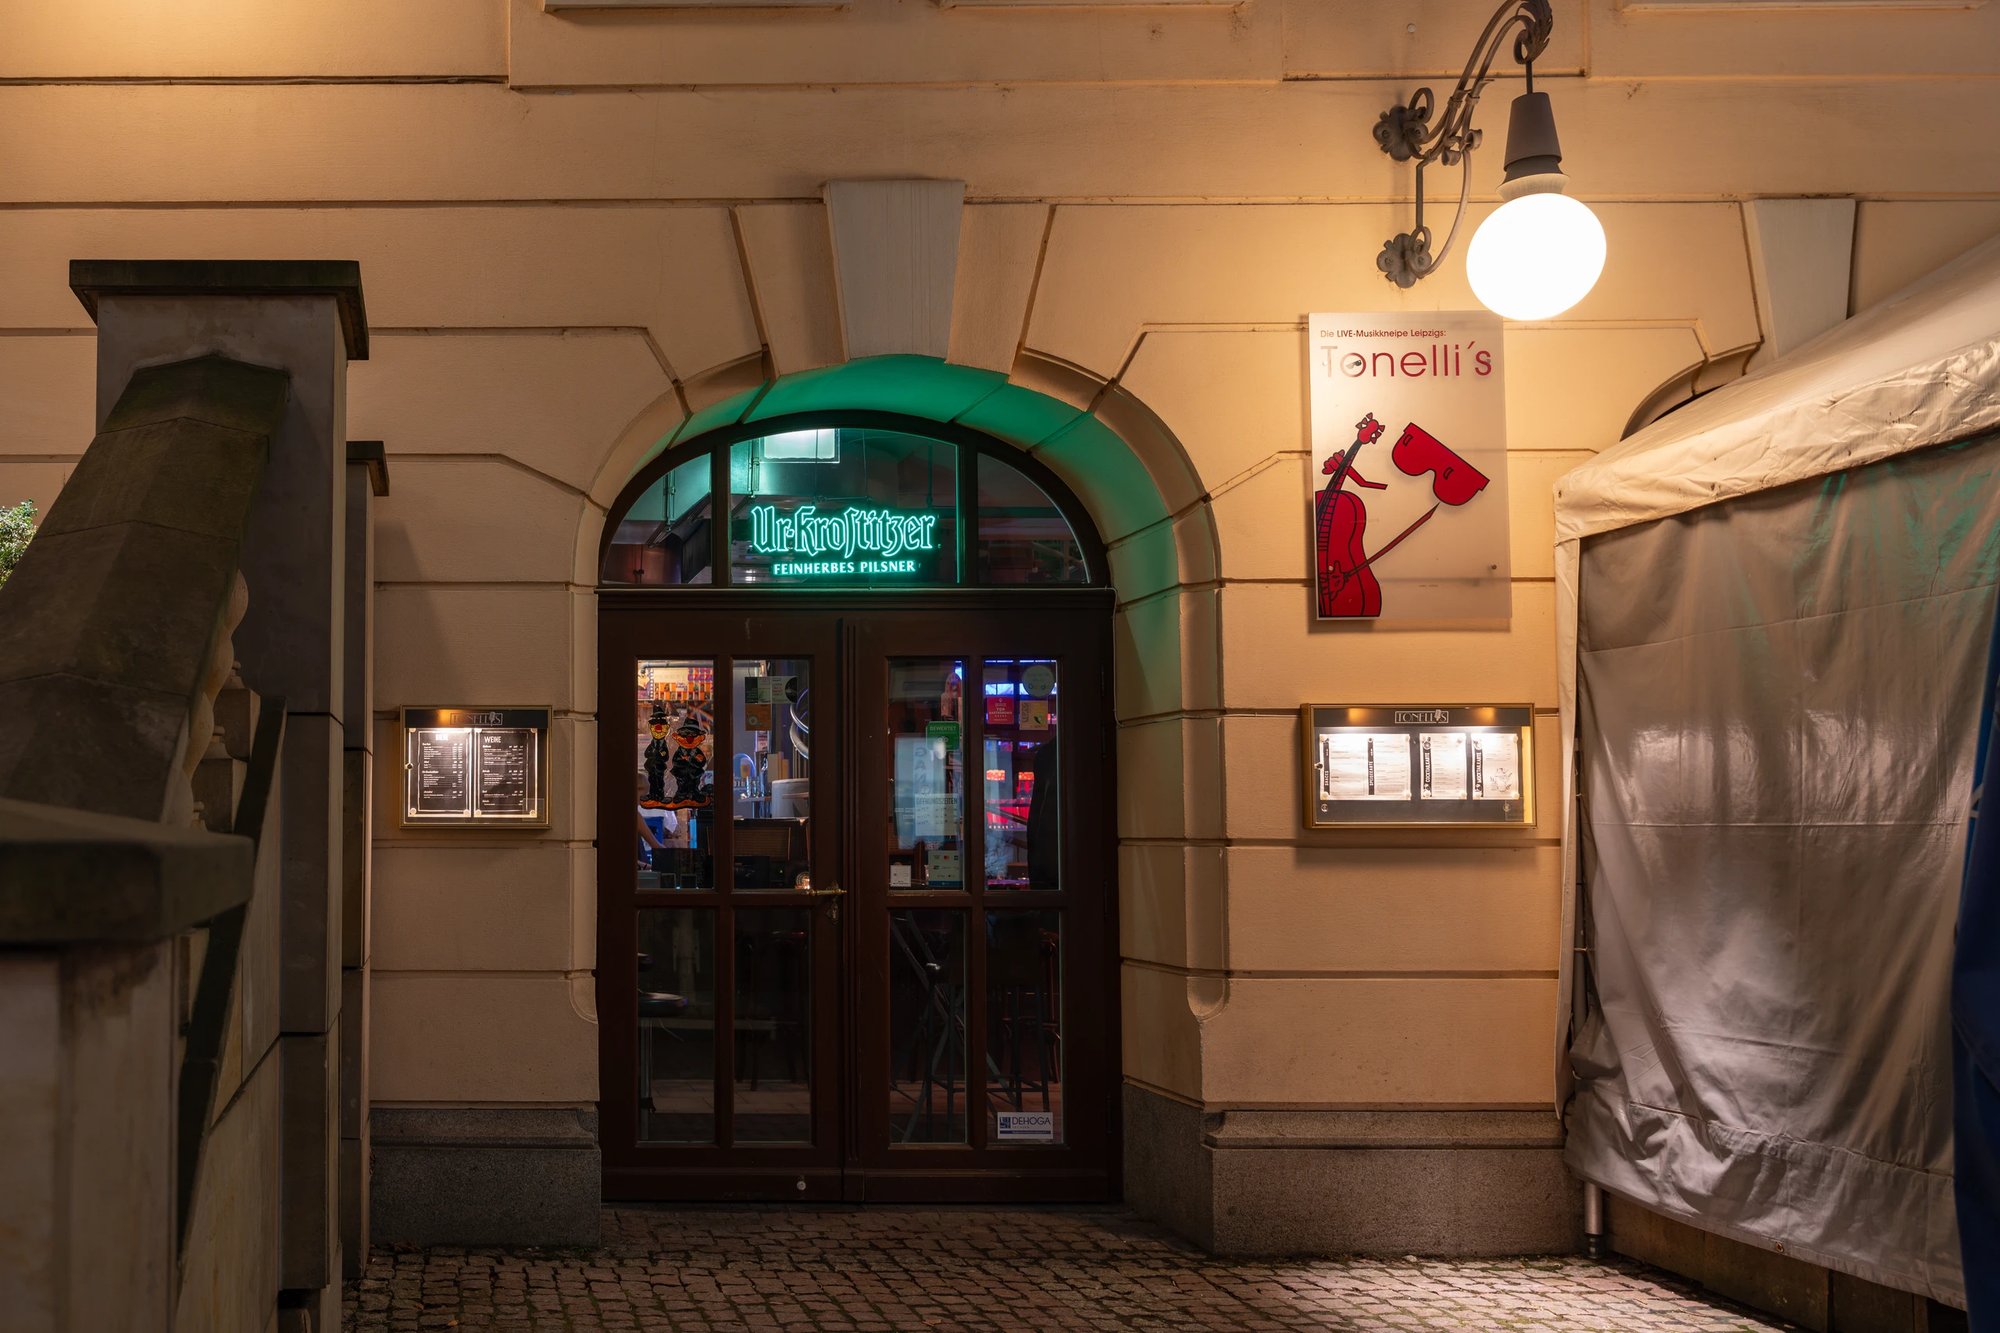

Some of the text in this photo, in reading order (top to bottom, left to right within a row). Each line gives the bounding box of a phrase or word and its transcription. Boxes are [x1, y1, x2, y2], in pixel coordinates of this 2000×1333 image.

[1320, 329, 1447, 339] Die LIVE-Musikkneipe Leipzigs:
[773, 560, 916, 576] FEINHERBES PILSNER
[1012, 1116, 1051, 1126] DEHOGA
